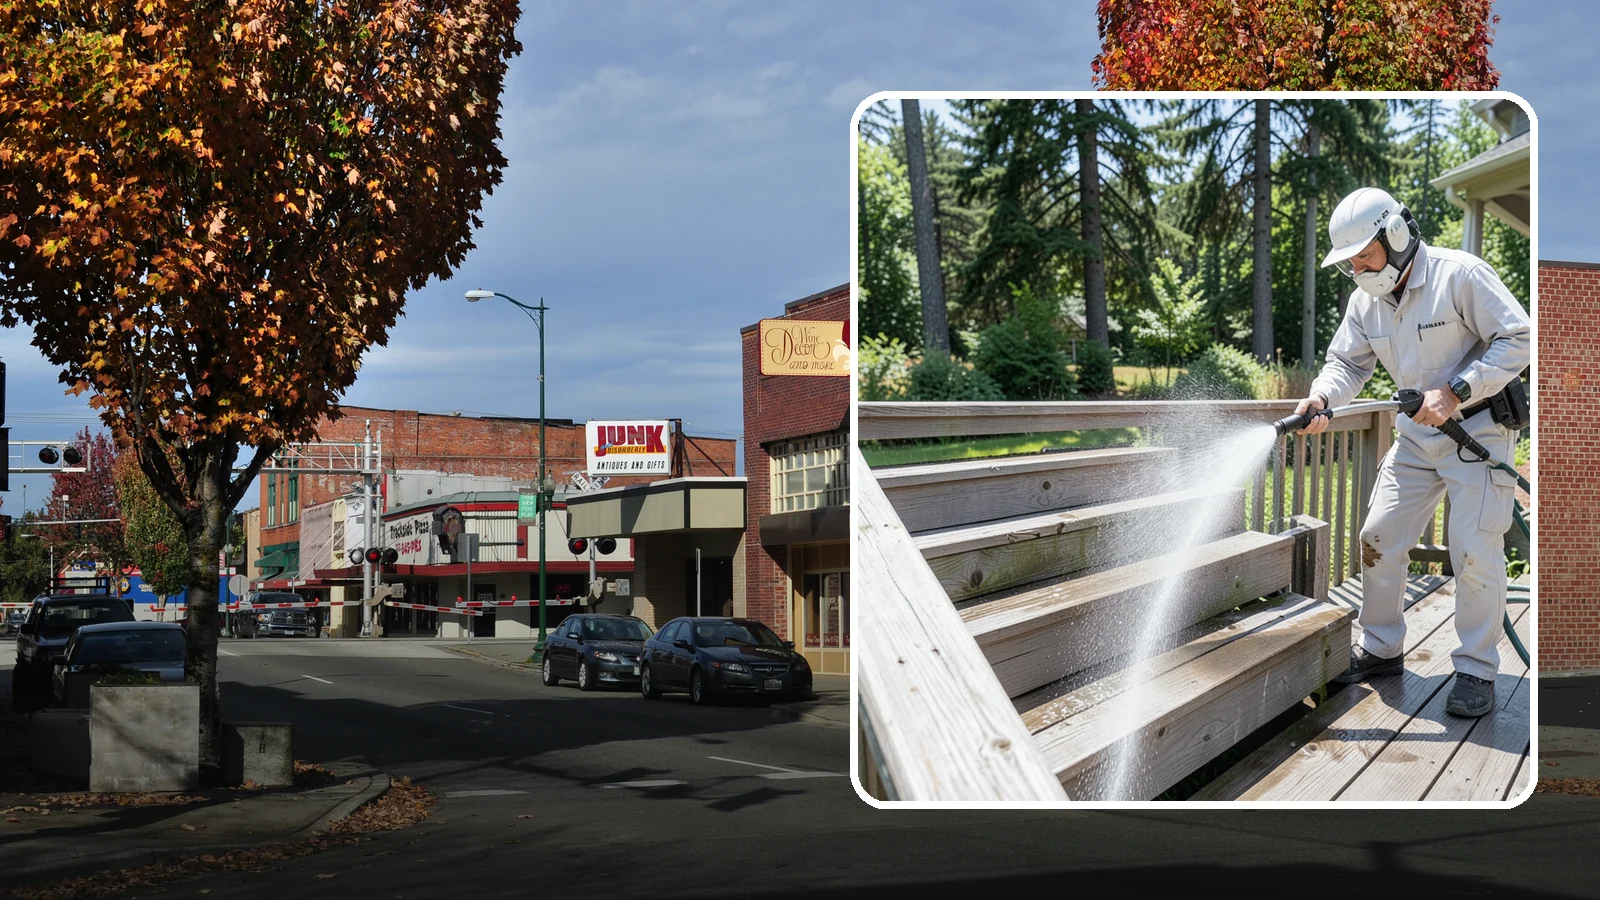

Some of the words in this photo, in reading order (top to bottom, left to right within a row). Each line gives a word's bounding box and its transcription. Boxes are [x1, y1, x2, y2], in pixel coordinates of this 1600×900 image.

[765, 327, 831, 365] Decor
[595, 425, 665, 457] JUNK
[607, 446, 646, 454] DISORDERLY
[597, 461, 628, 470] ANTIQUES
[631, 461, 644, 470] AND
[647, 460, 665, 469] GIFTS
[390, 521, 413, 539] Trackside
[414, 519, 429, 535] Pizza
